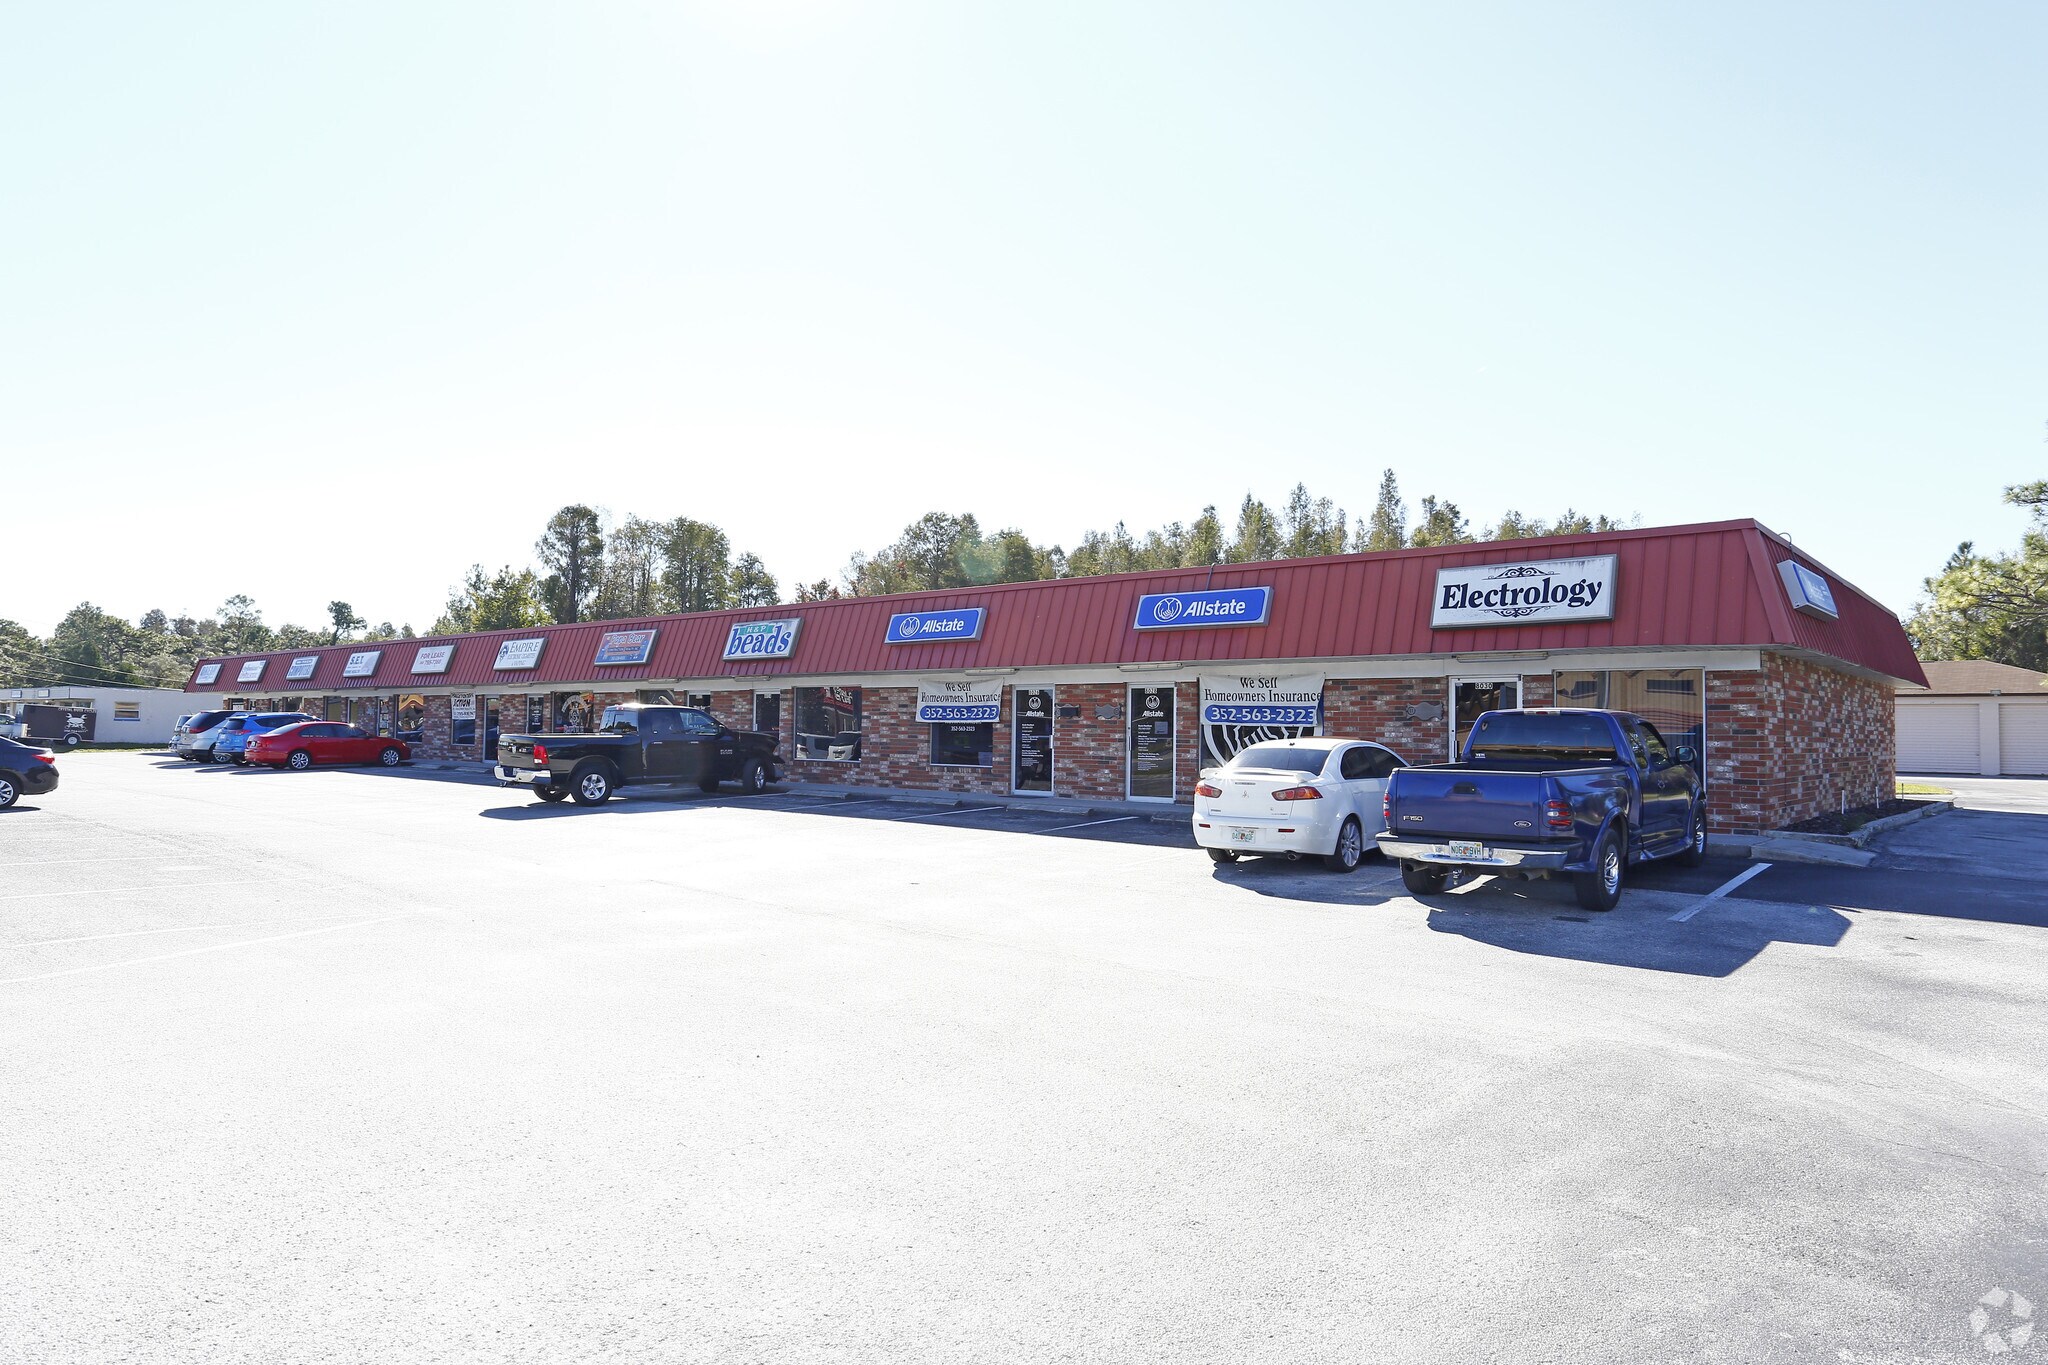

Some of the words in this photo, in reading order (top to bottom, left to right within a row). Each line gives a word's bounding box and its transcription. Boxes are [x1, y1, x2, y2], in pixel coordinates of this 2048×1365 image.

[1440, 577, 1602, 610] Electrology
[1183, 598, 1246, 617] Allstate
[919, 618, 964, 633] Allstate
[726, 625, 792, 656] beads
[509, 642, 540, 653] EMPIRE
[420, 652, 430, 660] FOR
[431, 651, 445, 659] LEASE
[945, 682, 956, 692] We
[957, 681, 972, 692] Sell
[1240, 677, 1255, 689] We
[1258, 676, 1278, 689] Sell
[920, 692, 964, 703] Homeowners
[1204, 689, 1266, 702] Homeowners
[1268, 689, 1321, 702] Insurance
[924, 707, 997, 719] 352-563-2323
[1210, 707, 1316, 722] 352-563-2323
